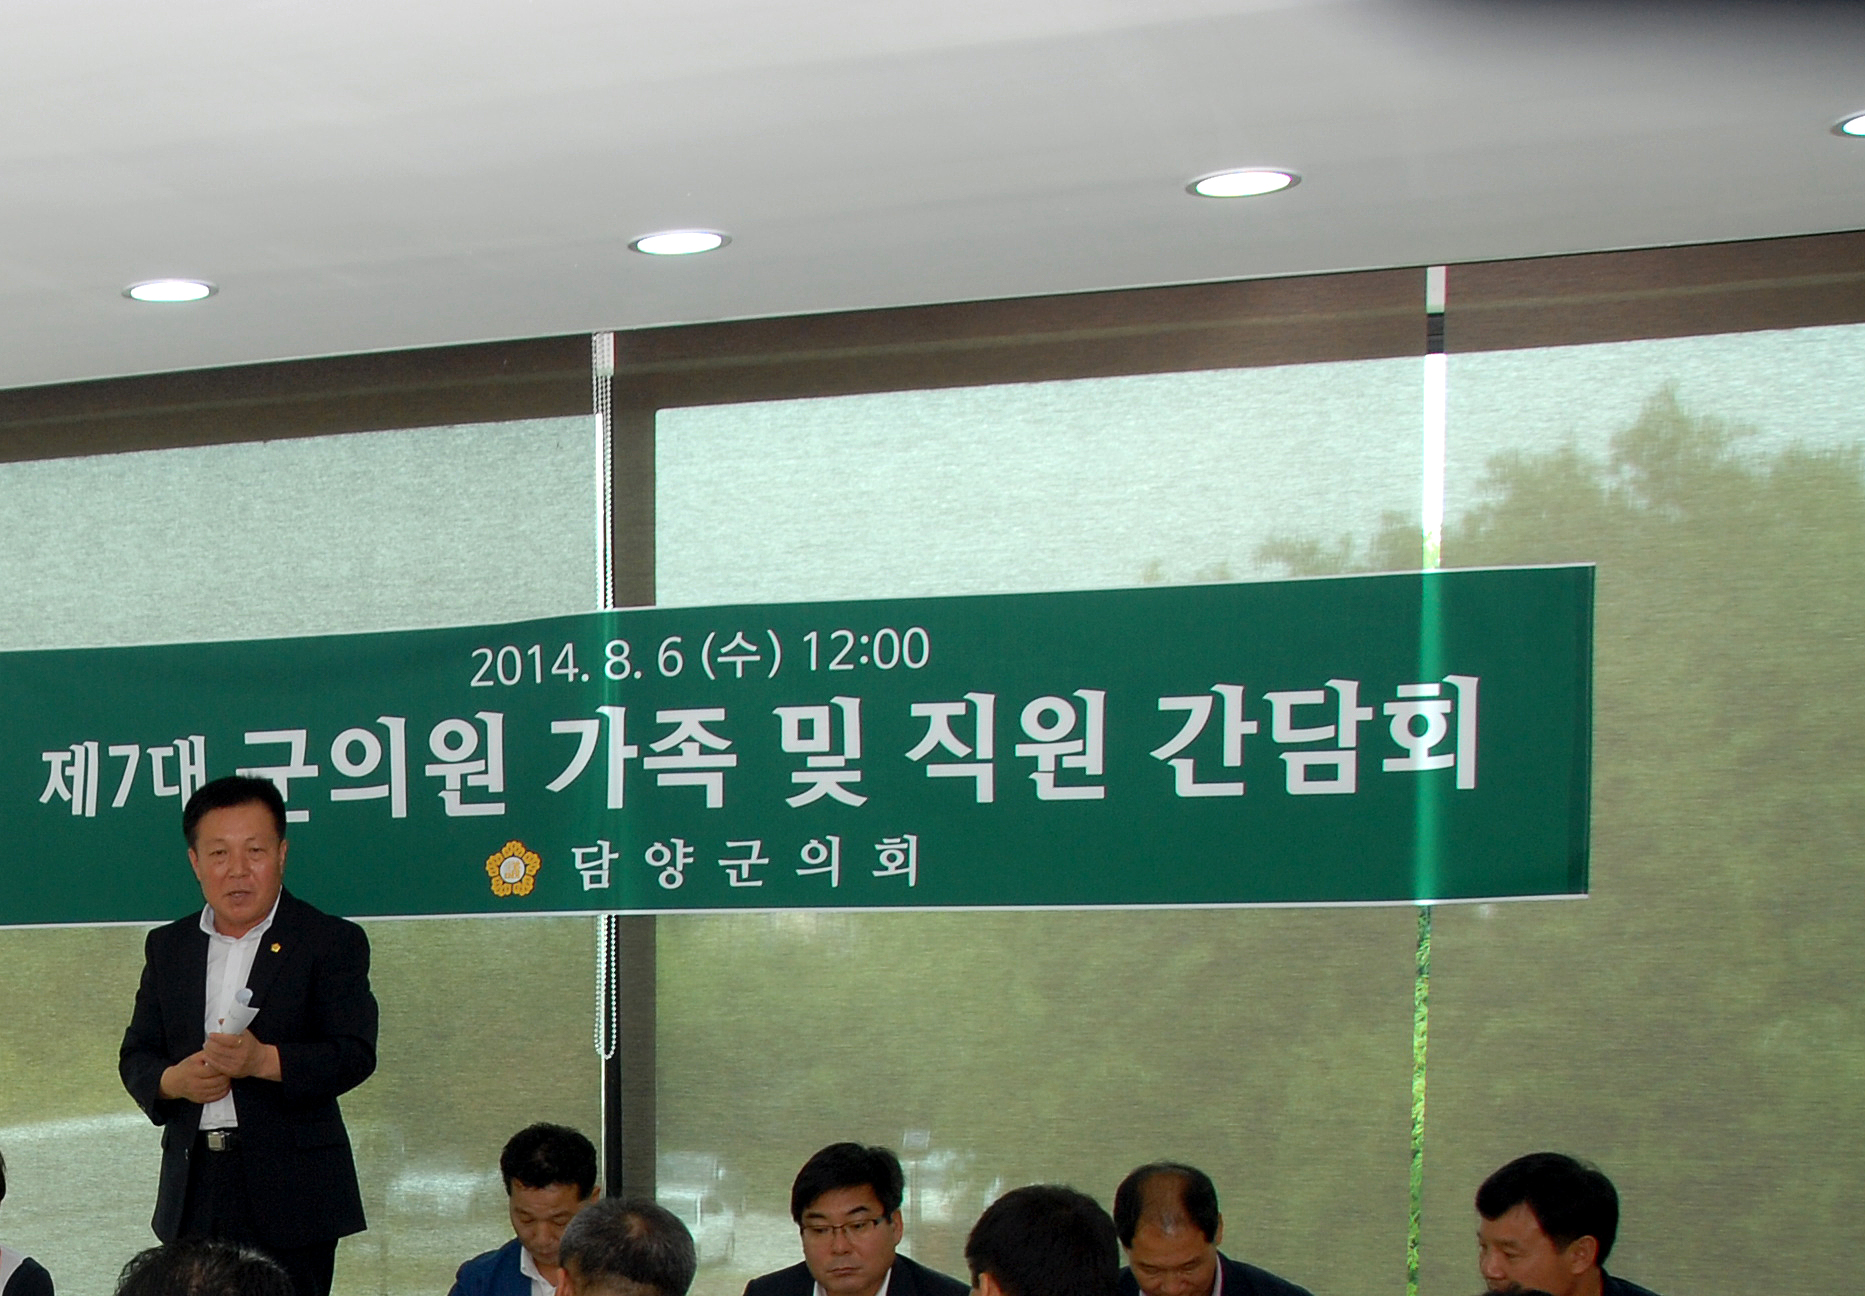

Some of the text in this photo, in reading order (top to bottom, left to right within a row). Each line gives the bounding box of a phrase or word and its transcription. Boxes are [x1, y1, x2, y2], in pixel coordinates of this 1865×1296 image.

[470, 643, 590, 688] 2014.
[657, 635, 684, 677] 6
[701, 629, 783, 681] (수)
[802, 626, 930, 672] 12:00
[39, 674, 1480, 823] 제7대 군의원 가족 및 직원 간담회
